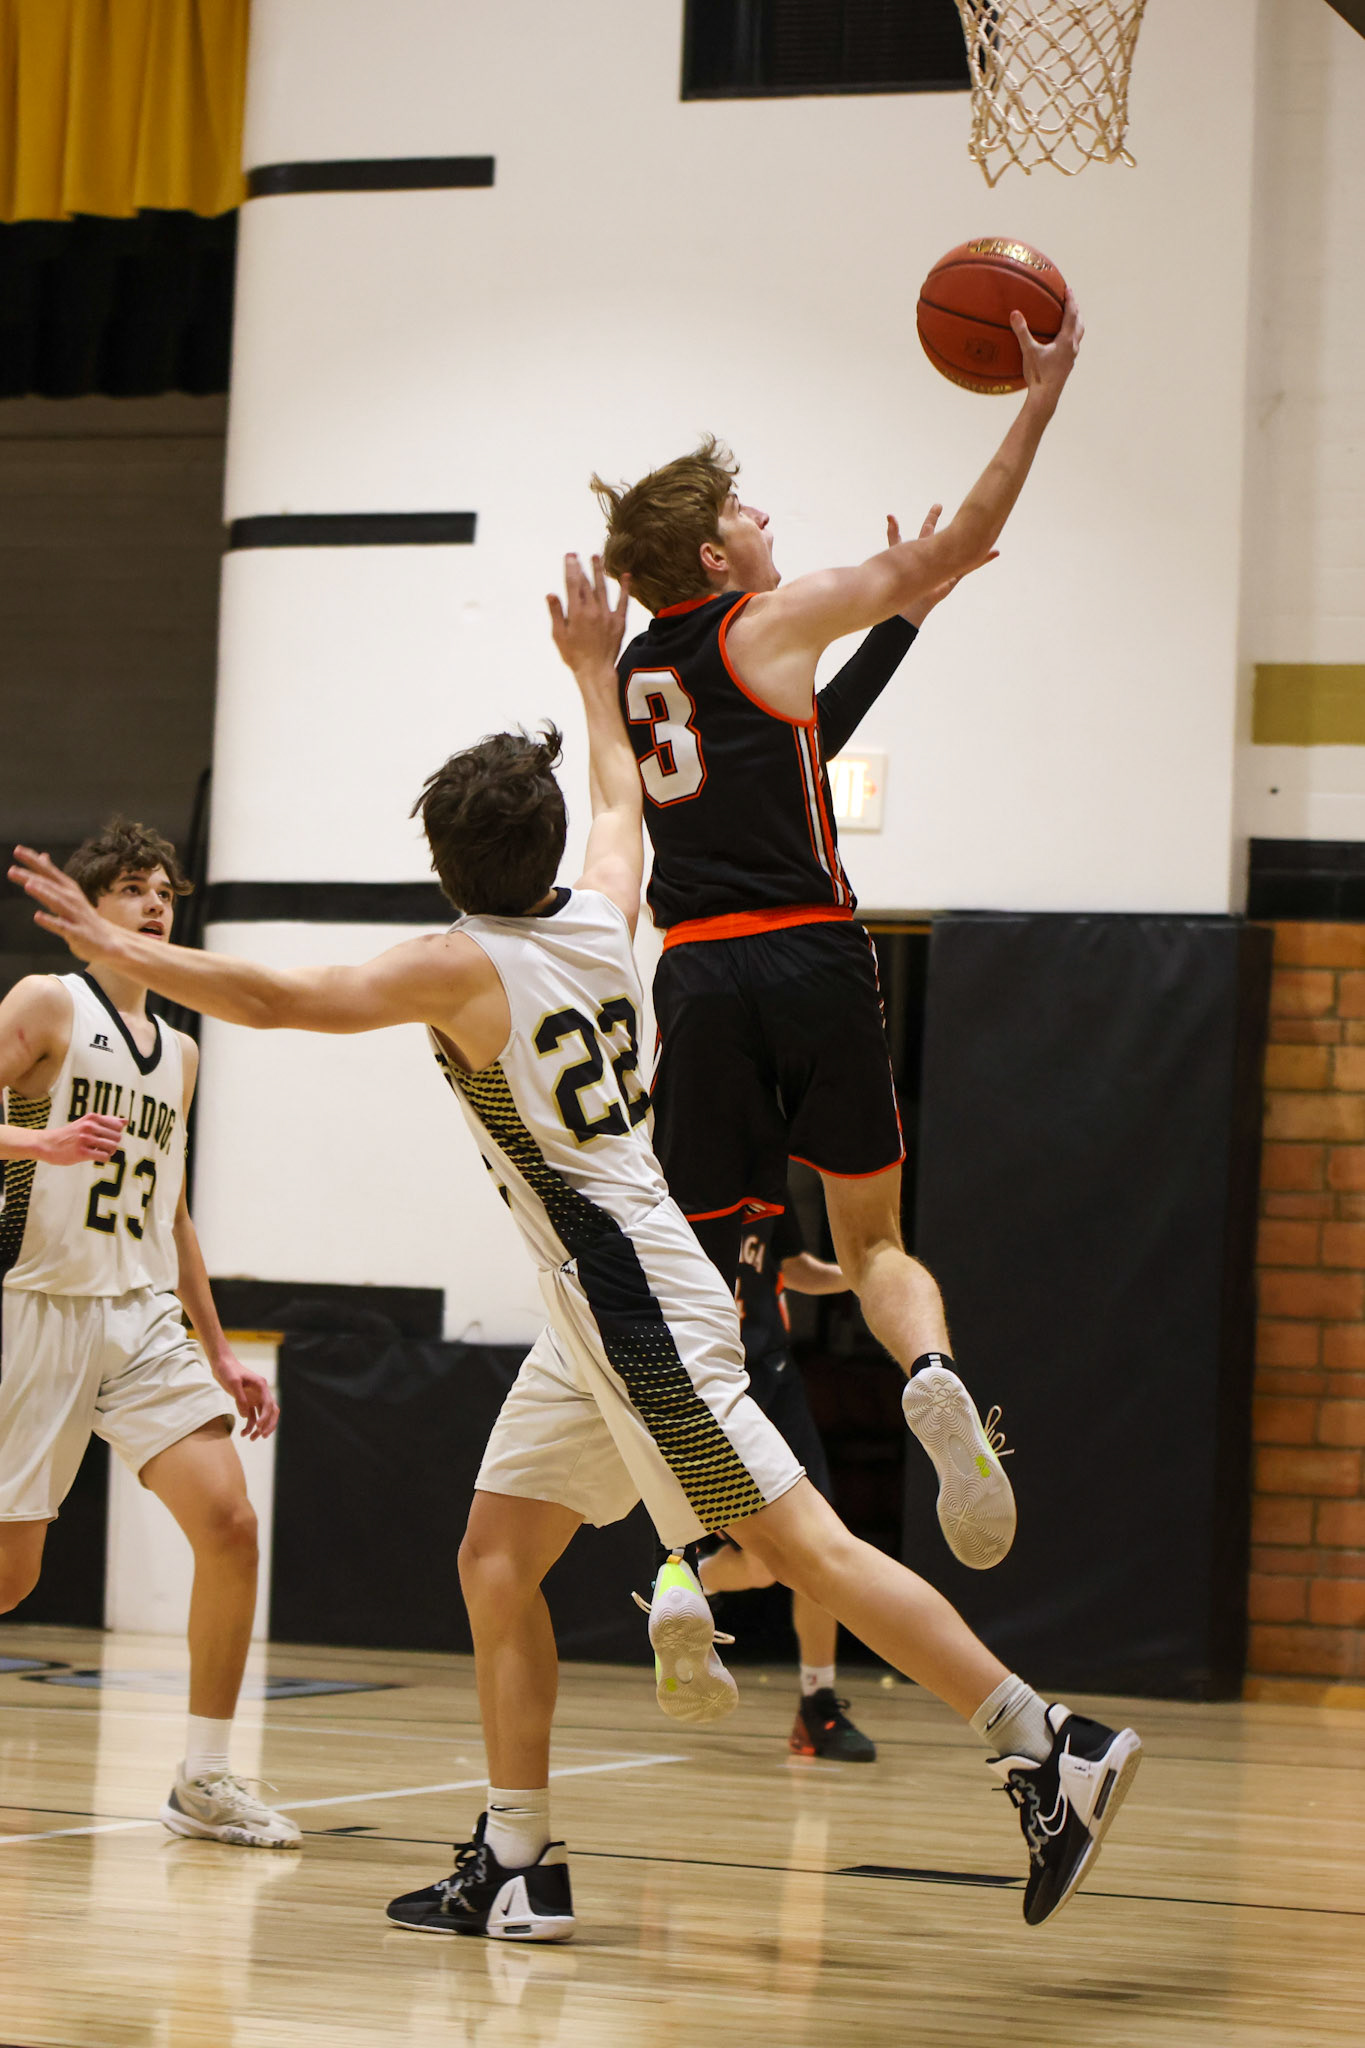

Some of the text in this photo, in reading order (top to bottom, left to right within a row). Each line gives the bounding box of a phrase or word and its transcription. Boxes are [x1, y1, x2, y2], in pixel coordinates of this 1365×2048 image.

[625, 666, 708, 809] 3
[68, 1077, 176, 1156] BULLDOG
[531, 992, 653, 1149] 22
[84, 1147, 157, 1242] 23
